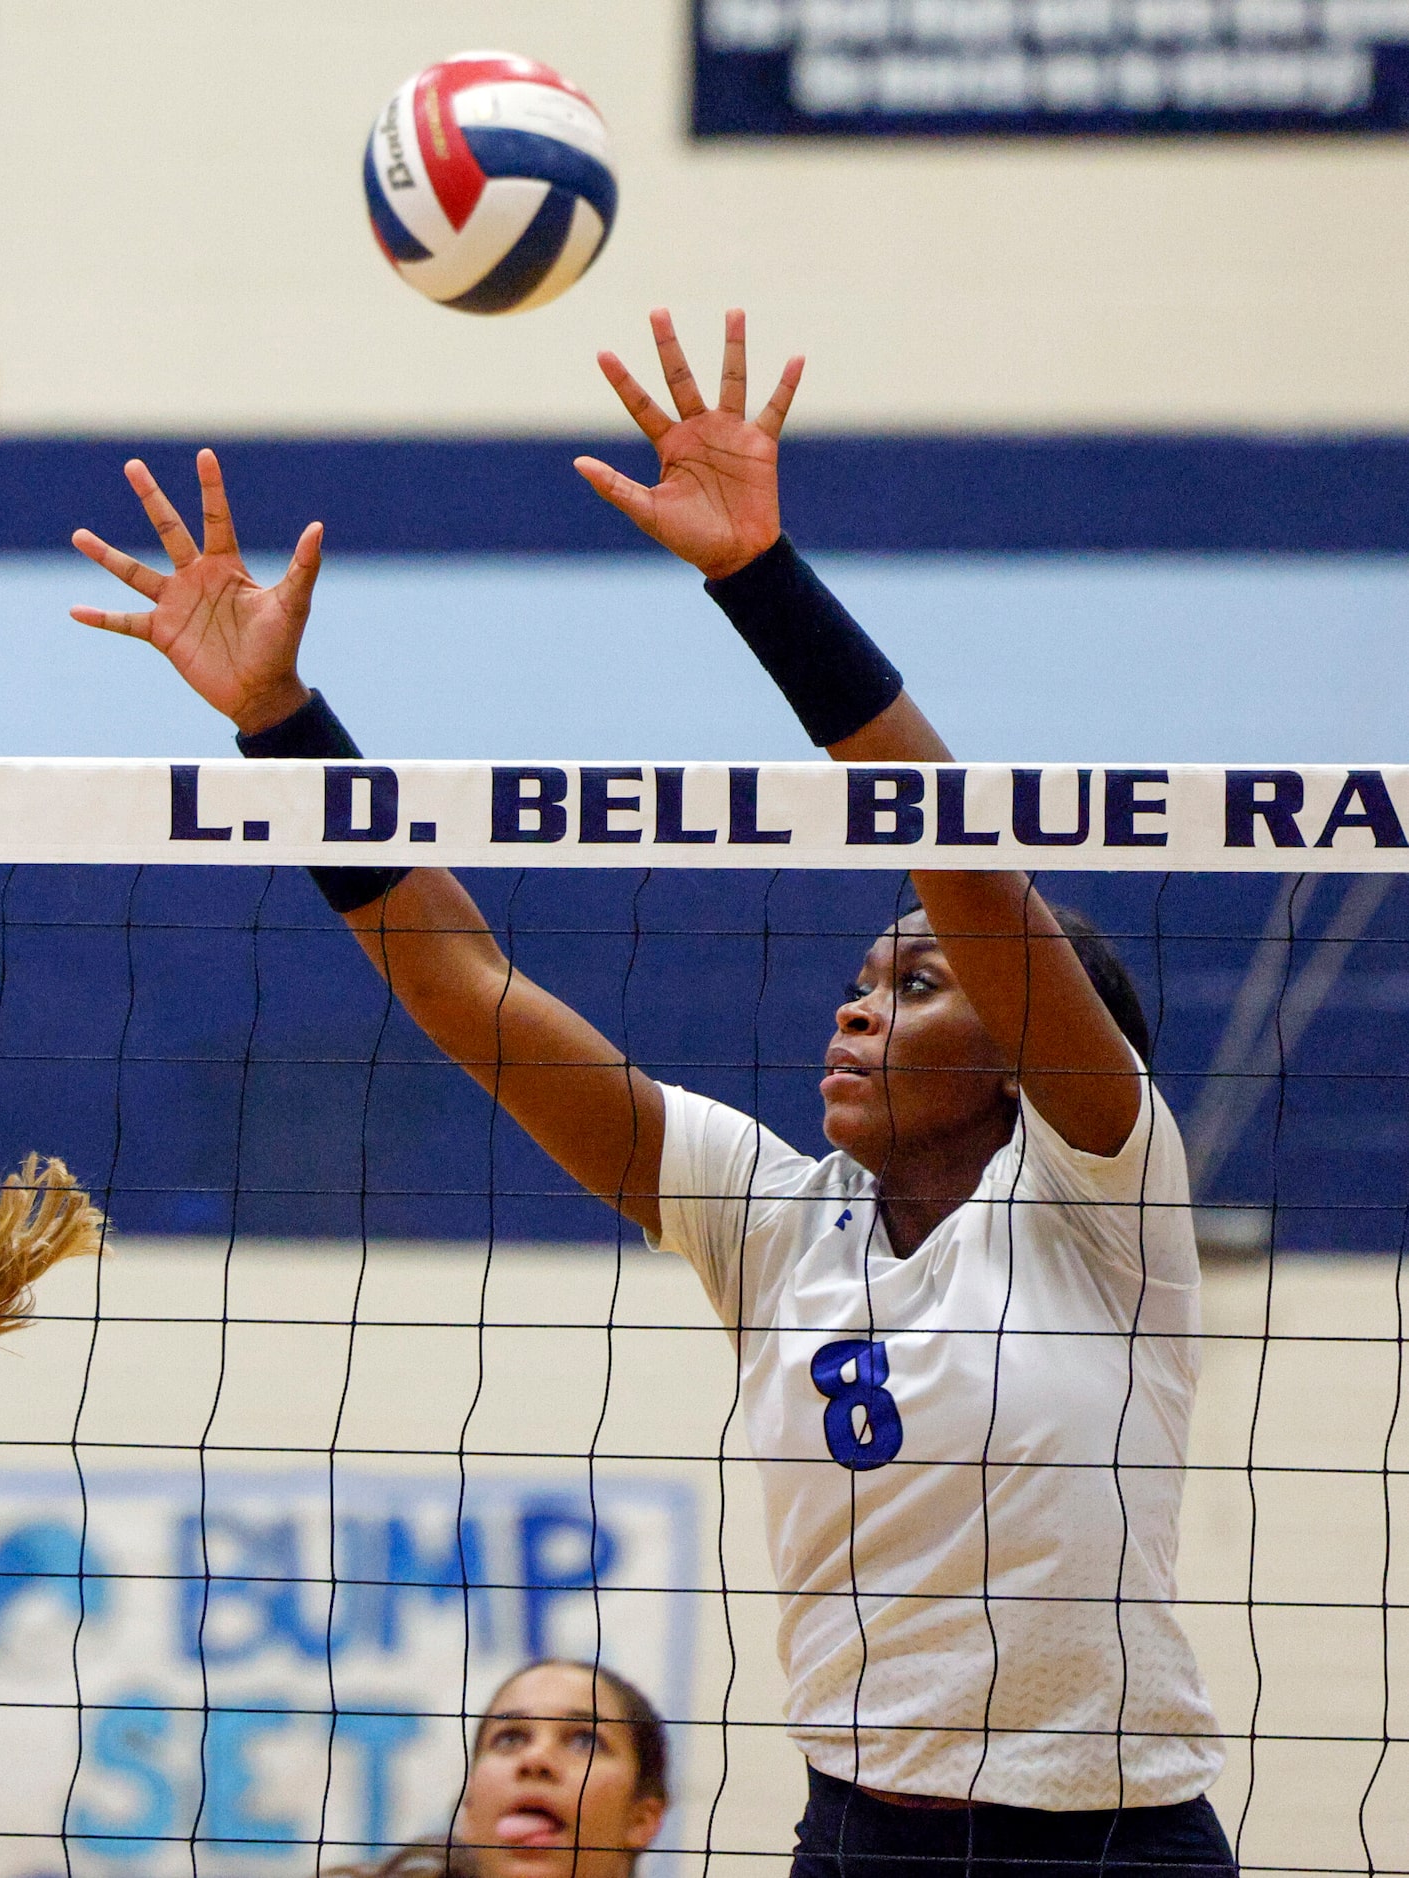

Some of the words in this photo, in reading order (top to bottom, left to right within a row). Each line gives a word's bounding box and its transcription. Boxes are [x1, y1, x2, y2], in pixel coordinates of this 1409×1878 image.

[169, 764, 270, 841] L.
[322, 765, 437, 842] D.
[490, 766, 793, 845] BELL
[844, 767, 1171, 847] BLUE
[1223, 769, 1409, 848] RA
[810, 1339, 904, 1472] 8
[177, 1500, 617, 1662] BUMP
[75, 1686, 423, 1858] SET
